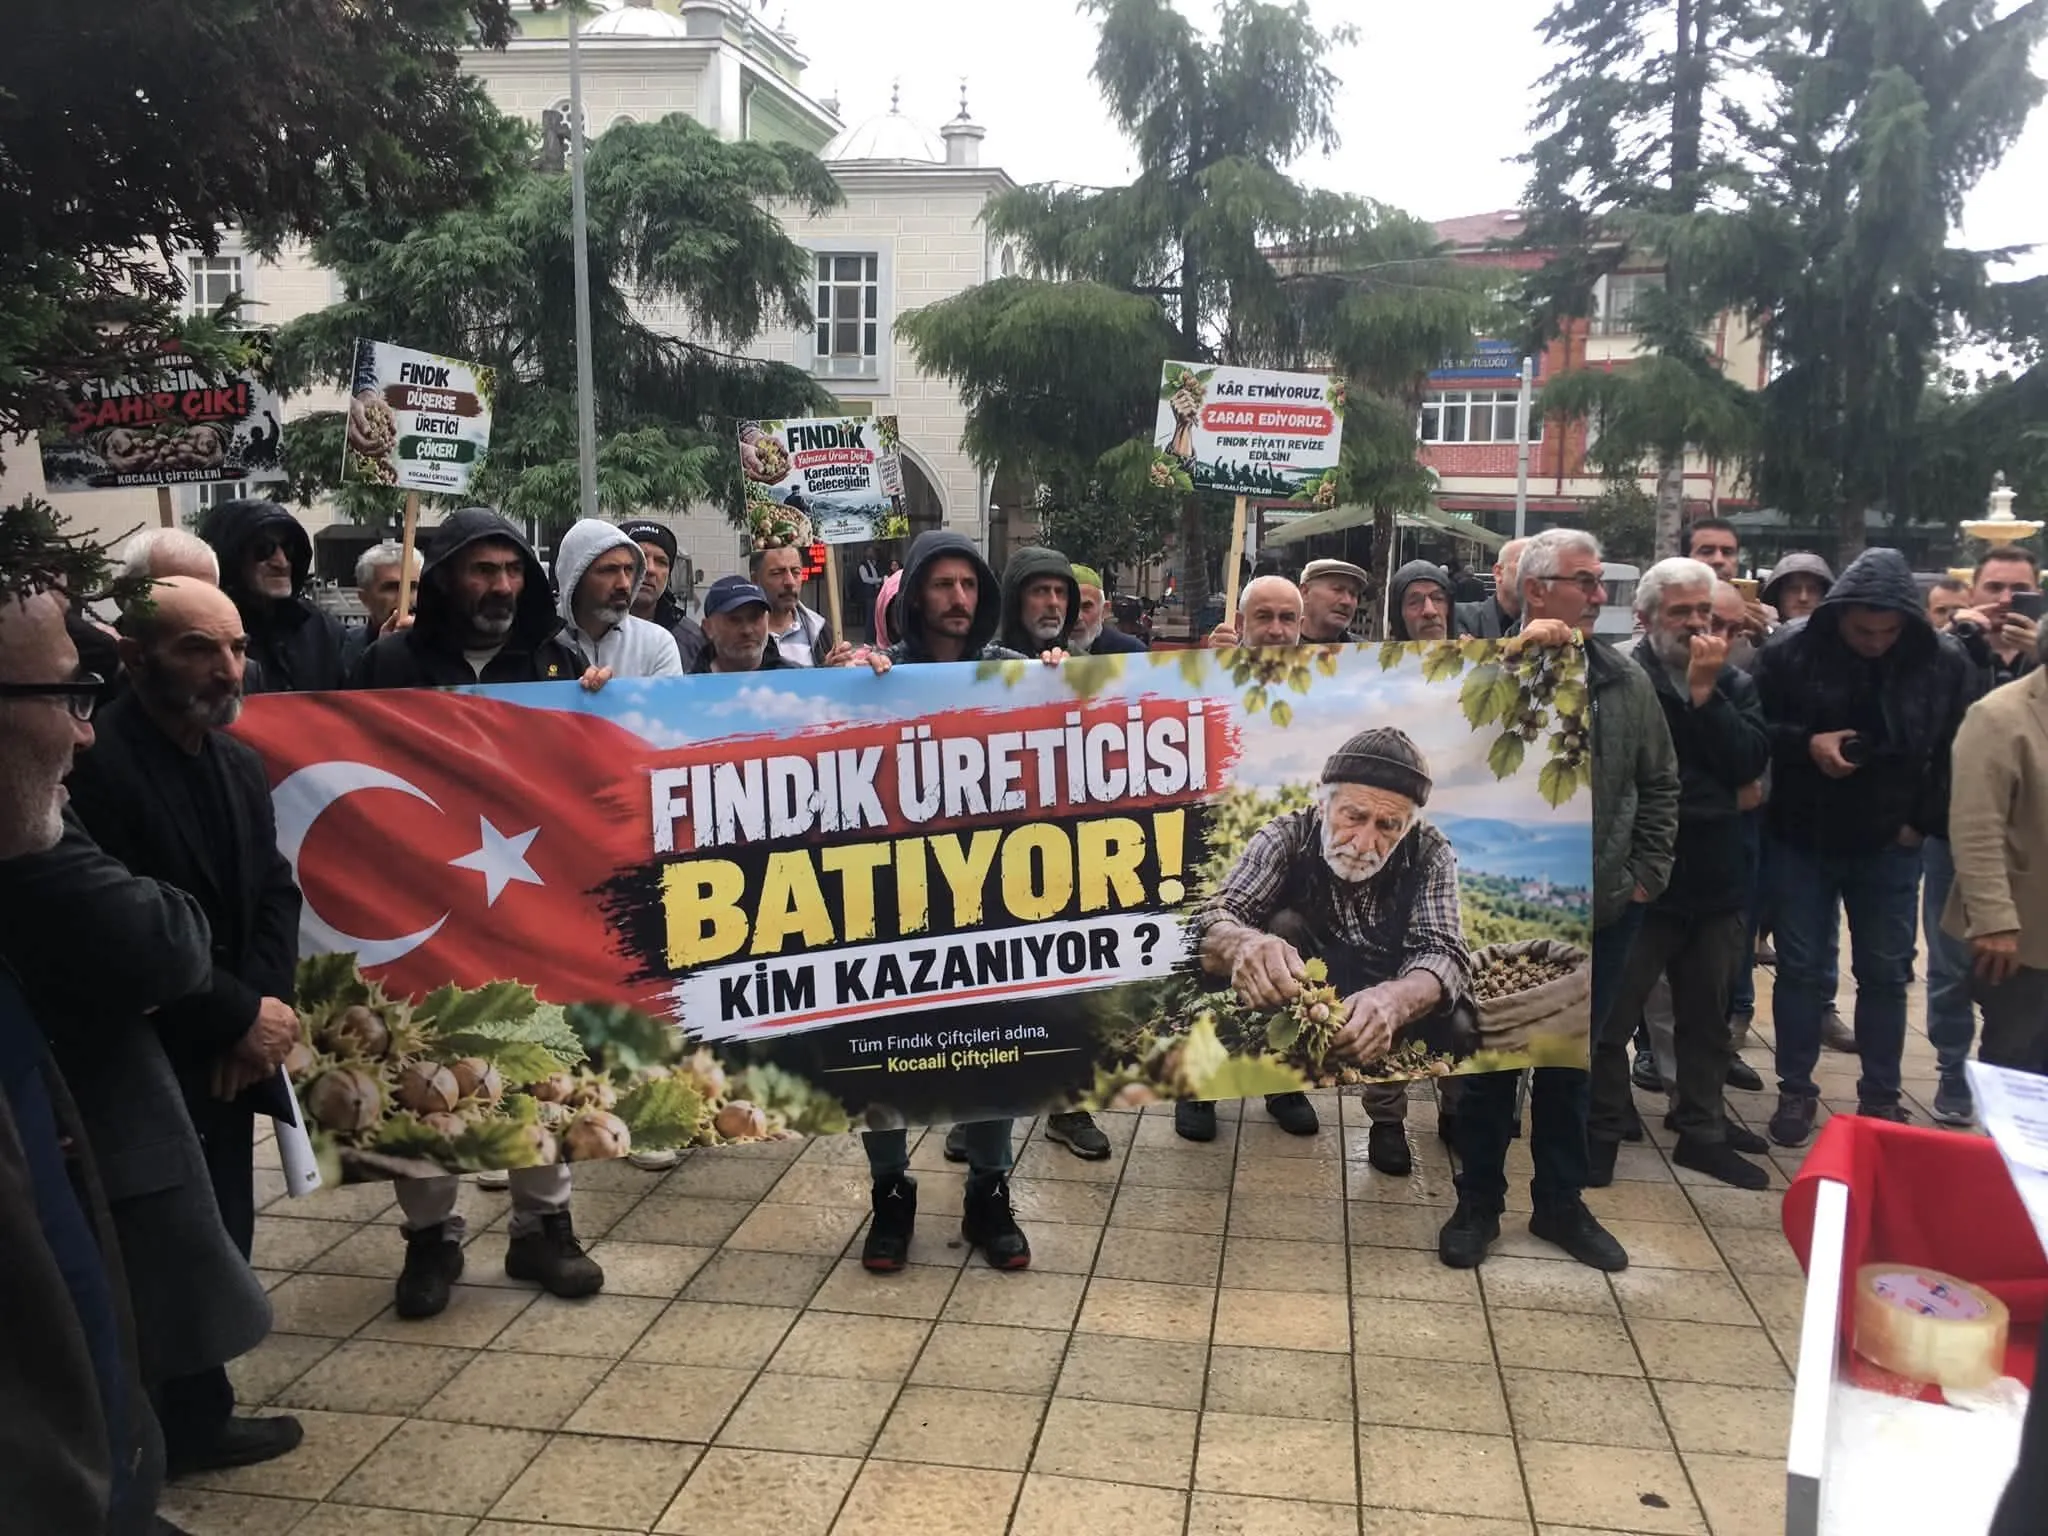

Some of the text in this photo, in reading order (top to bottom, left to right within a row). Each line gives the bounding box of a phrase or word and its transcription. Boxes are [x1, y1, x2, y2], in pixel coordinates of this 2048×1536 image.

[400, 362, 450, 387] FINDIK
[406, 388, 457, 411] DÜŞERSE
[1216, 380, 1243, 396] KÂR
[416, 412, 459, 435] ÜRETİCİ
[1207, 410, 1254, 425] ZARAR
[787, 424, 865, 453] FINDIK
[1216, 435, 1324, 450] FINDIK FİYATI REVİZE
[804, 464, 869, 481] Karadeniz'in
[651, 700, 1207, 855] FINDIK ÜRETİCİSİ
[661, 808, 1186, 971] BATIYOR!
[720, 922, 1161, 1021] KİM KAZANIYOR ?
[848, 1038, 883, 1054] Tüm
[937, 1026, 1001, 1049] Çiftçileri
[1004, 1024, 1049, 1040] adına,
[887, 1045, 1020, 1073] Kocaali Çiftçileri
